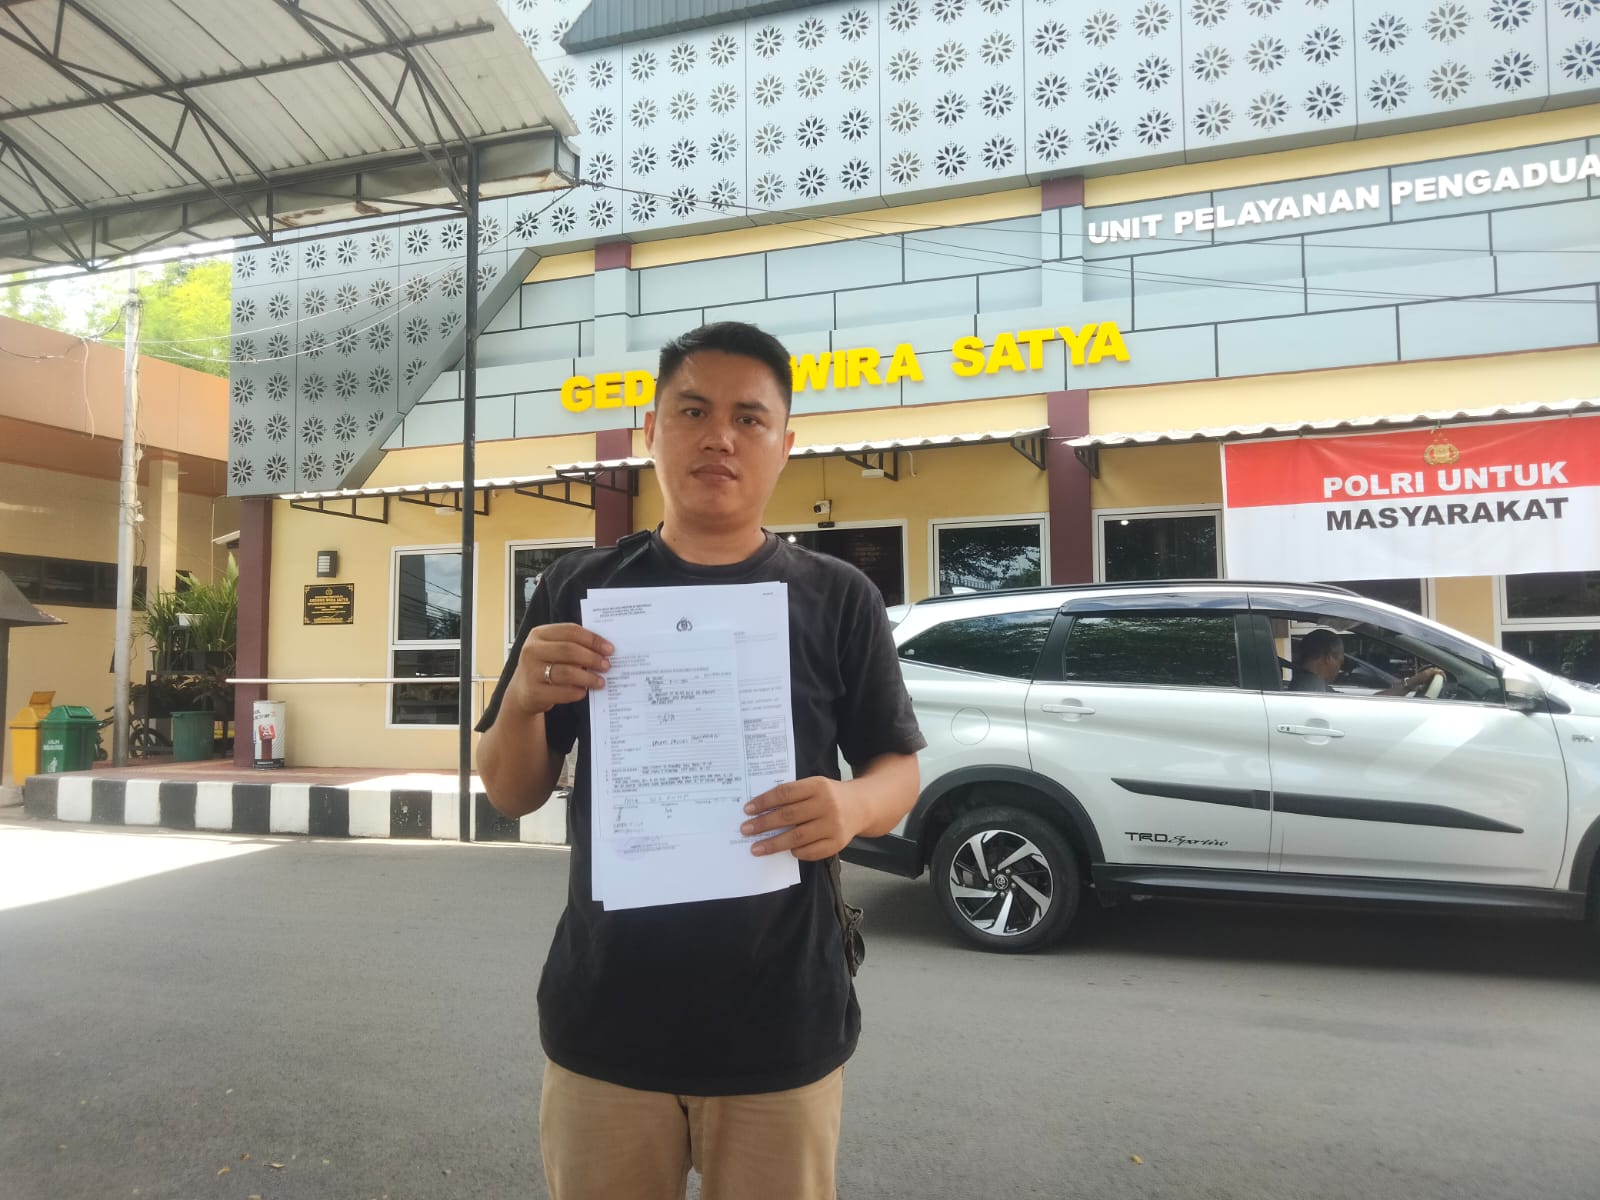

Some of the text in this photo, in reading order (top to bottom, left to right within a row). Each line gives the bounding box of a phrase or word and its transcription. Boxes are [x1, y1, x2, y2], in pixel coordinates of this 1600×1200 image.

[1088, 213, 1163, 244] UNIT
[1174, 184, 1380, 235] PELAYANAN
[561, 321, 1130, 413] GED WIRA SATYA
[1323, 460, 1568, 499] POLRI UNTUK
[1326, 497, 1569, 531] MASYARAKAT
[1124, 831, 1168, 843] TRD
